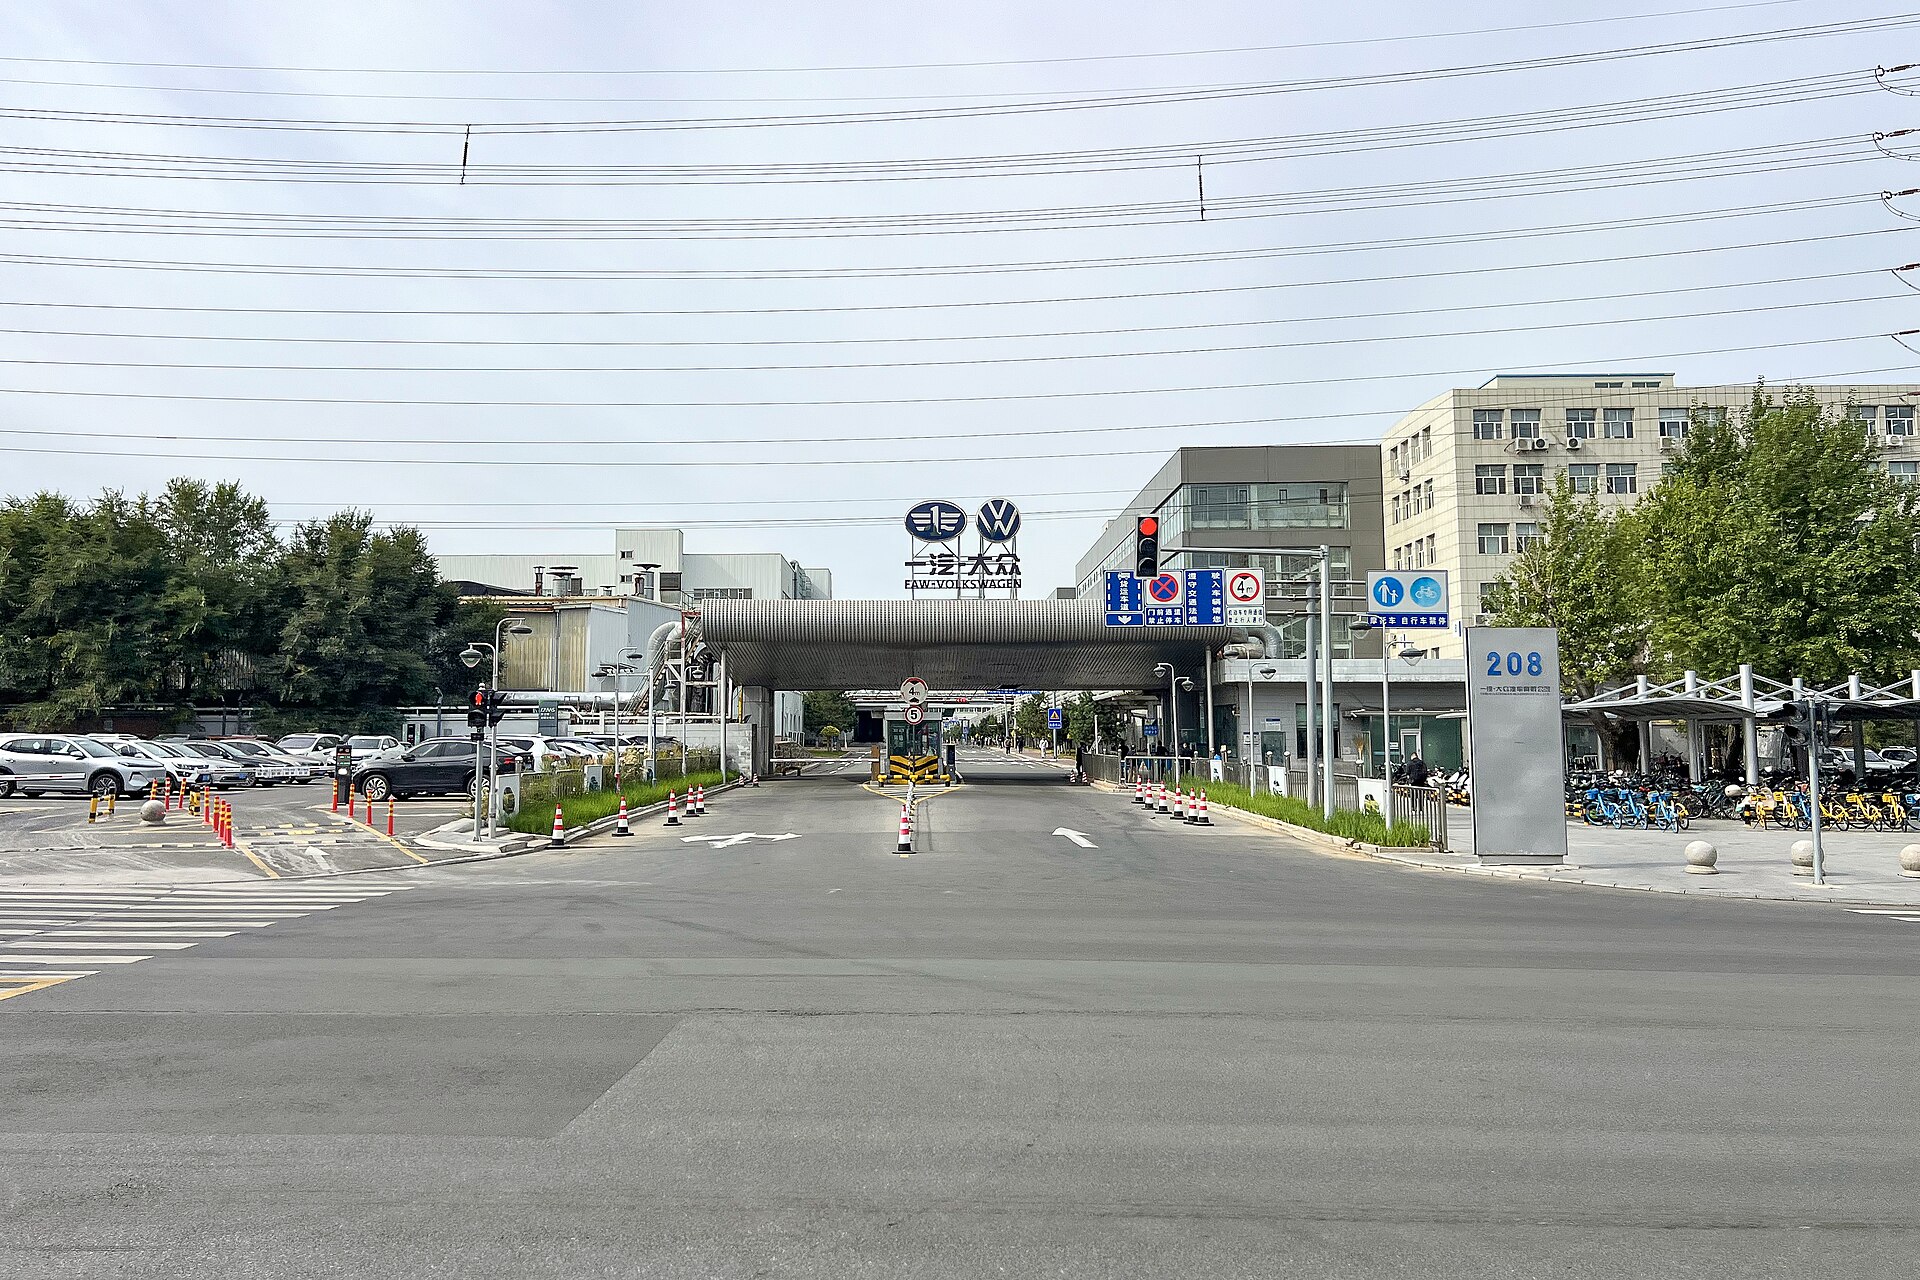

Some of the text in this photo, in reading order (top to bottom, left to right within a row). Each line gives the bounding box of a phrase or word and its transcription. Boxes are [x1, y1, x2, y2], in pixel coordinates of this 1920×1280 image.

[904, 579, 1022, 589] FAW-VOLKSWAGEN
[1119, 580, 1130, 611] 货运车道
[1187, 572, 1198, 624] 遵守交通法规
[1211, 572, 1222, 623] 驶入车辆请您
[1148, 617, 1181, 625] 禁止停车
[1401, 616, 1447, 625] 自行车禁停
[1486, 651, 1543, 677] 208
[910, 709, 918, 720] 5
